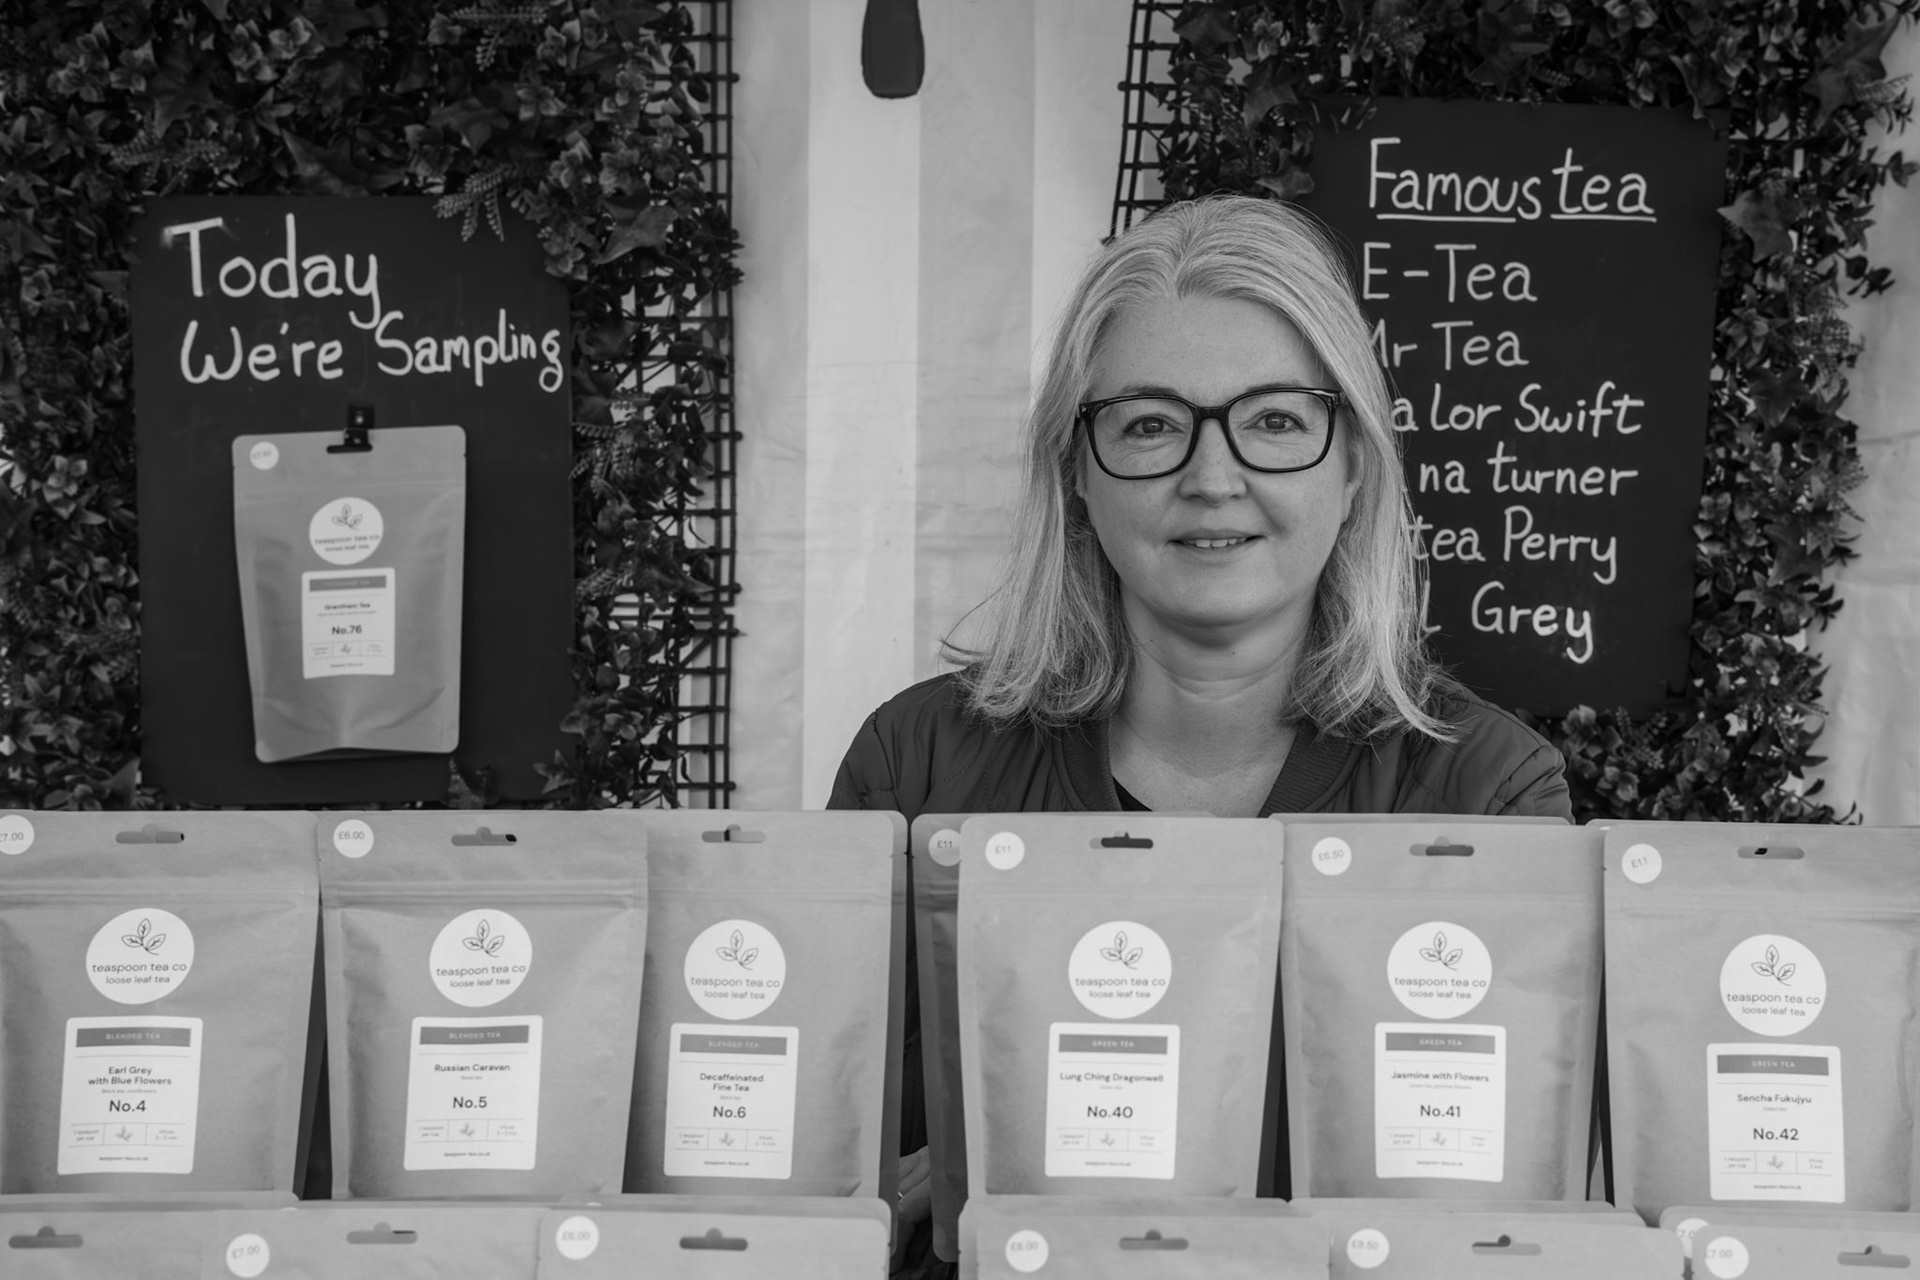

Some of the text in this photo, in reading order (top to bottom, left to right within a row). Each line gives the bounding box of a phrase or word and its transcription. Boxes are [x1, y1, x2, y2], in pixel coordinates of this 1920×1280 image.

[1369, 137, 1656, 219] Famous tea
[163, 213, 380, 330] Today
[181, 308, 564, 393] We're Sampling
[1431, 320, 1530, 370] Tea
[1514, 381, 1645, 437] Swift
[1487, 441, 1639, 496] turner
[1504, 505, 1617, 585] Perry
[1471, 581, 1595, 664] Grey
[331, 623, 363, 635] No.76
[937, 839, 953, 849] £11
[994, 844, 1012, 855] £11
[1631, 856, 1648, 868] £11
[92, 963, 187, 975] teaspoon tea co
[436, 965, 526, 978] teaspoon tea co
[106, 976, 132, 984] loose
[134, 975, 151, 983] leaf
[450, 980, 475, 988] loose
[477, 978, 494, 987] leaf
[691, 977, 781, 988] teaspoon tea co
[1075, 978, 1166, 988] teaspoon tea co
[1394, 977, 1487, 988] teaspoon tea co
[704, 989, 765, 1000] loose leaf tea
[1089, 990, 1114, 998] loose
[1116, 990, 1133, 998] leaf
[1408, 989, 1471, 999] loose leaf tea
[1726, 993, 1820, 1005] teaspoon tea co
[1742, 1006, 1805, 1016] loose leaf tea
[106, 1032, 161, 1040] BLENDED TEA
[1419, 1038, 1446, 1046] GREEN
[434, 1063, 511, 1072] Russian Caravan
[1751, 1060, 1778, 1068] GREEN
[108, 1066, 153, 1076] Earl Grey
[1391, 1071, 1490, 1082] Jasmine with Flowers
[88, 1076, 172, 1085] with Blue Flowers
[700, 1073, 764, 1082] Decaffeinated
[1060, 1072, 1164, 1083] Lung Ching Dragonwell
[713, 1083, 750, 1092] Fine Tea
[452, 1096, 488, 1109] No.5
[1737, 1093, 1812, 1105] Sencha Fukujyu
[109, 1100, 147, 1112] No.4
[1420, 1105, 1461, 1118] No.41
[713, 1106, 747, 1119] No.6
[1087, 1106, 1134, 1119] No.40
[1753, 1128, 1799, 1141] No.42
